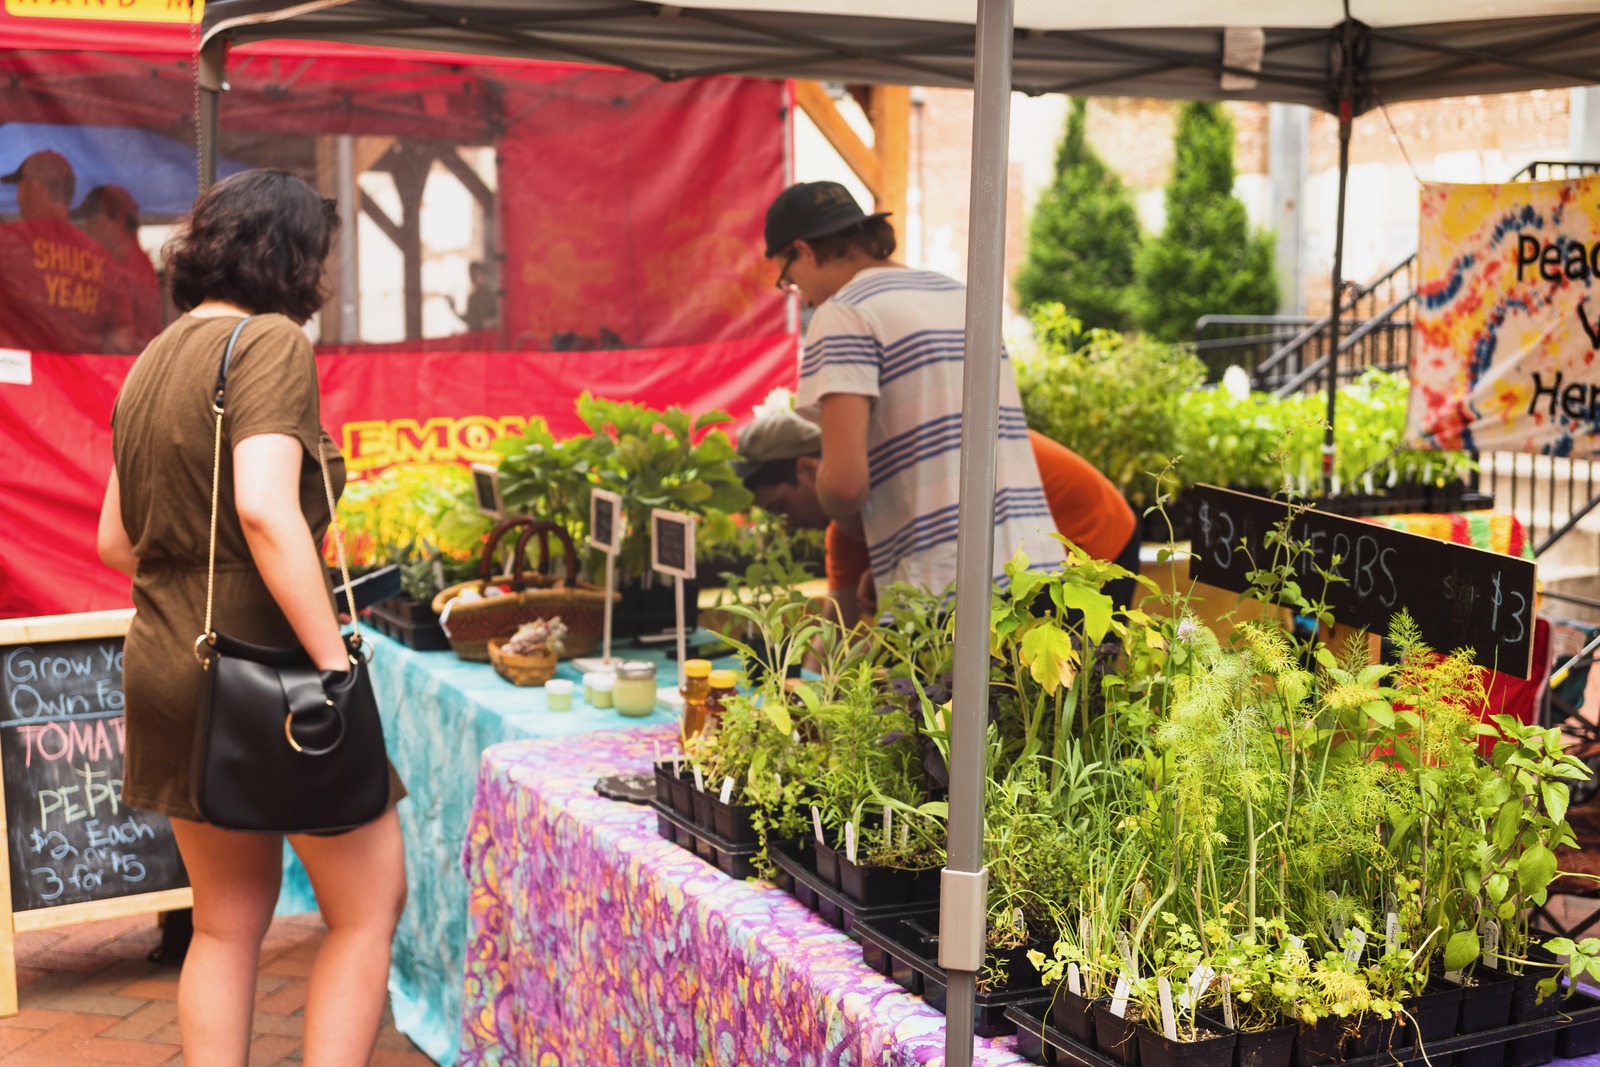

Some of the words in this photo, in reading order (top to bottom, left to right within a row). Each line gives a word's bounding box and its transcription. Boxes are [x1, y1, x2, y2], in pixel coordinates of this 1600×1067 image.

[33, 239, 105, 285] SHUCK
[1199, 501, 1235, 569] $3
[1287, 519, 1398, 608] HERBS
[1491, 570, 1526, 643] $3
[7, 646, 91, 682] Grow
[10, 683, 90, 720] Own
[30, 827, 79, 860] $2
[85, 815, 155, 848] Each
[83, 847, 111, 865] or
[31, 867, 64, 900] 3
[68, 863, 105, 891] for
[111, 851, 146, 882] $5
